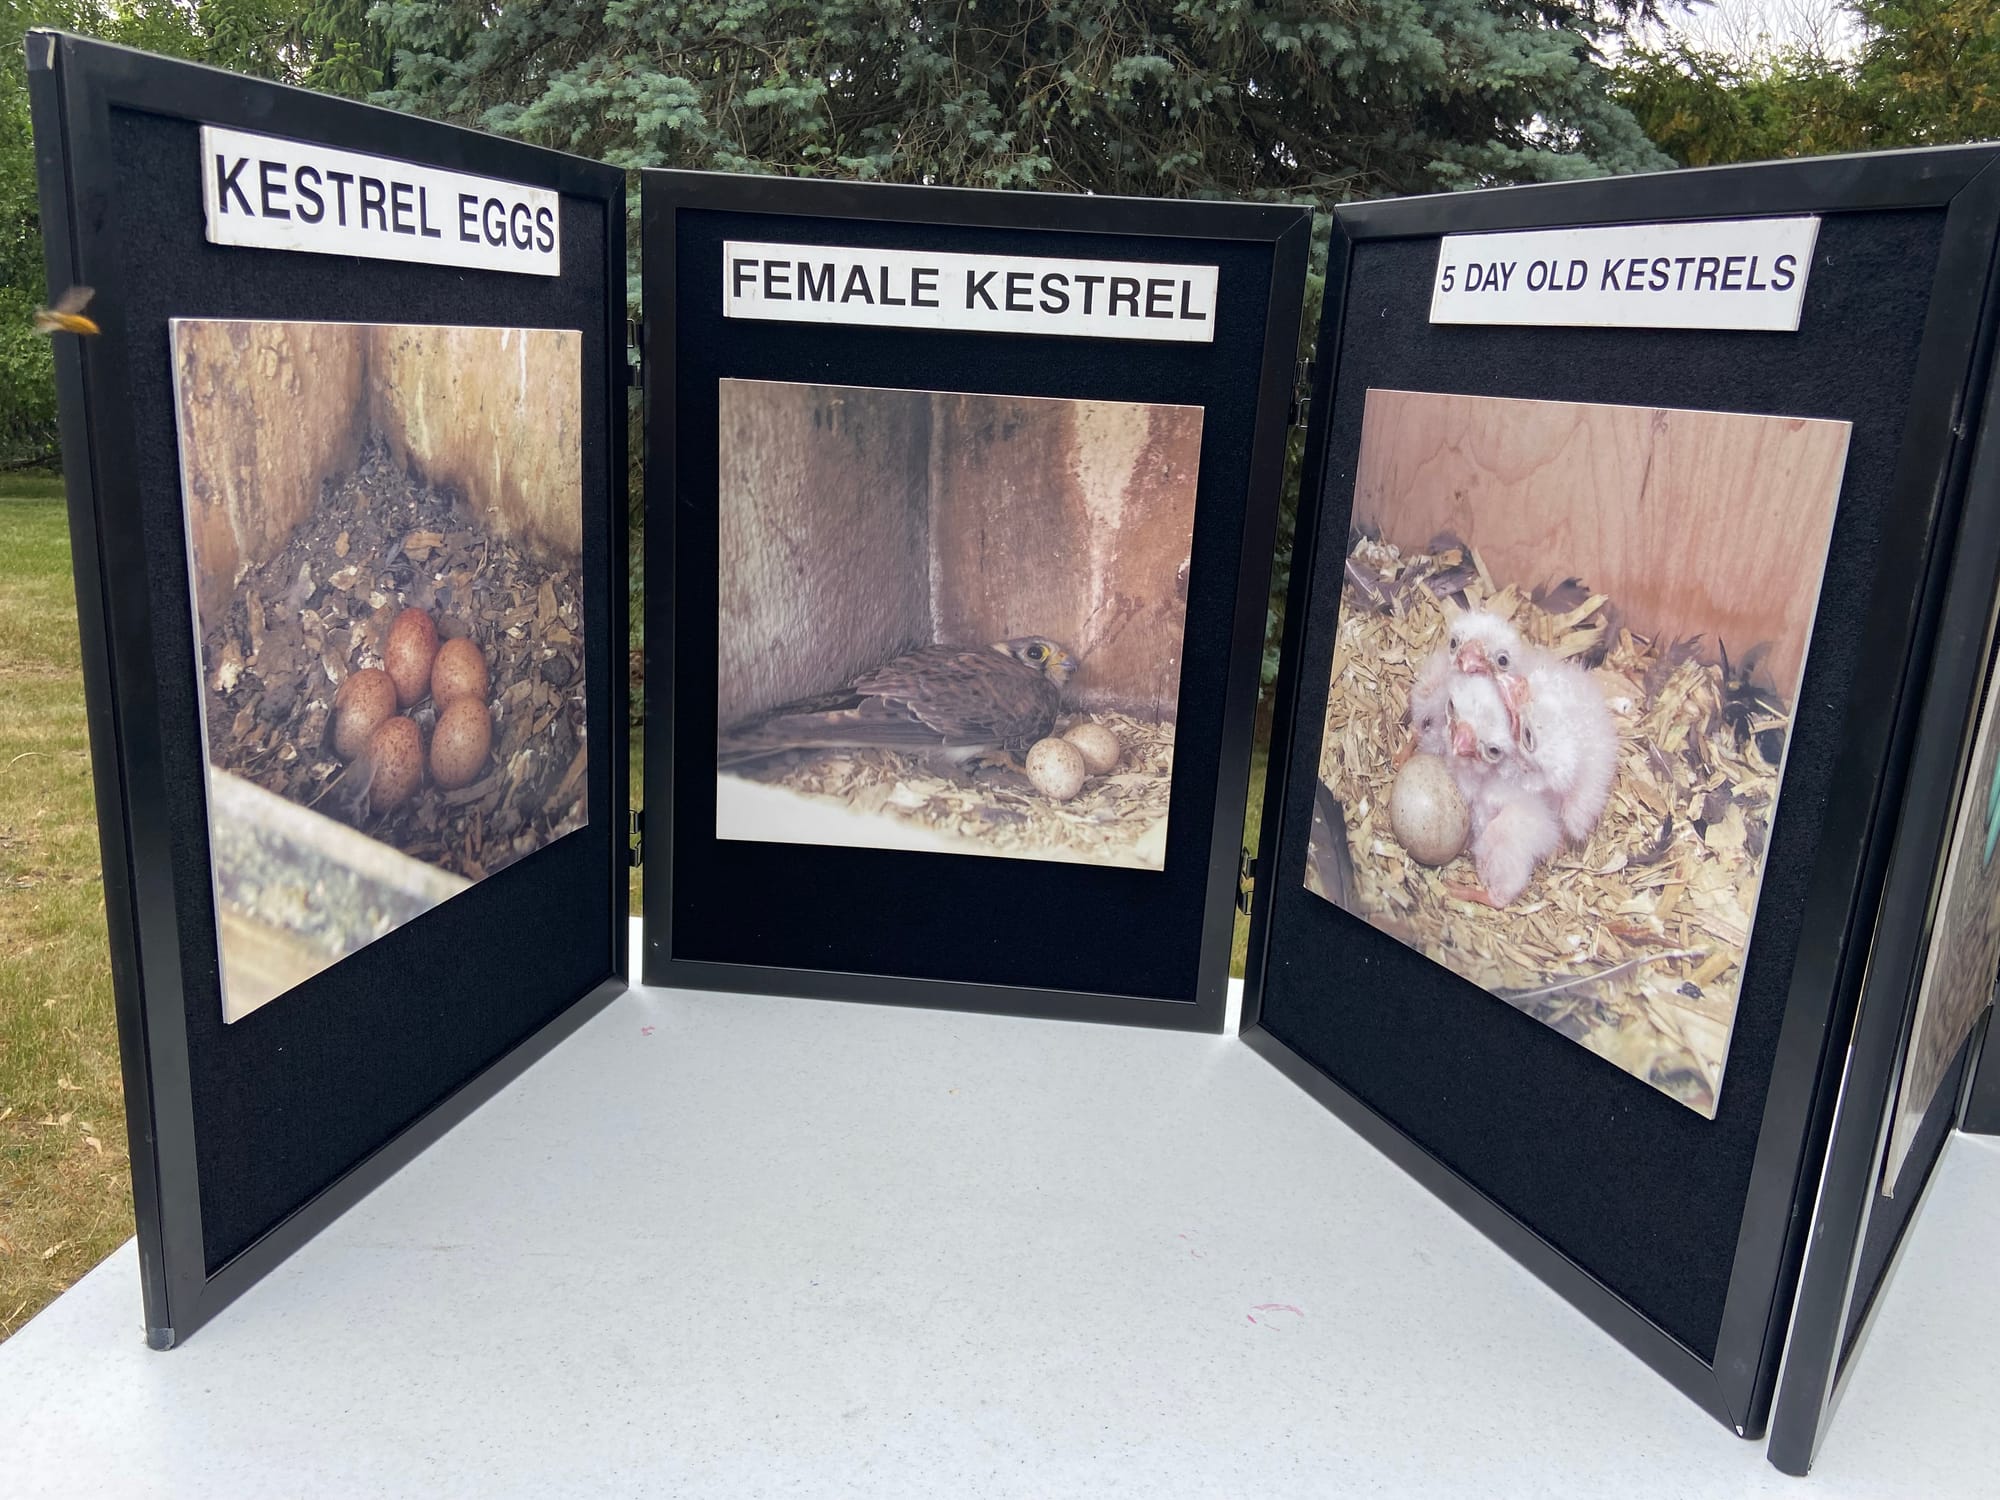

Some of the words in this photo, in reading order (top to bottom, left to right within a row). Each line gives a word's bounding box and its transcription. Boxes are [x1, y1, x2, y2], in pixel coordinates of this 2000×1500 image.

[215, 154, 442, 239] KESTREL
[458, 193, 555, 254] EGGS
[732, 258, 940, 309] FEMALE
[965, 269, 1207, 321] KESTREL
[1440, 265, 1456, 293] 5
[1464, 261, 1518, 293] DAY
[1526, 260, 1589, 293] OLD
[1600, 254, 1798, 293] KESTRELS
